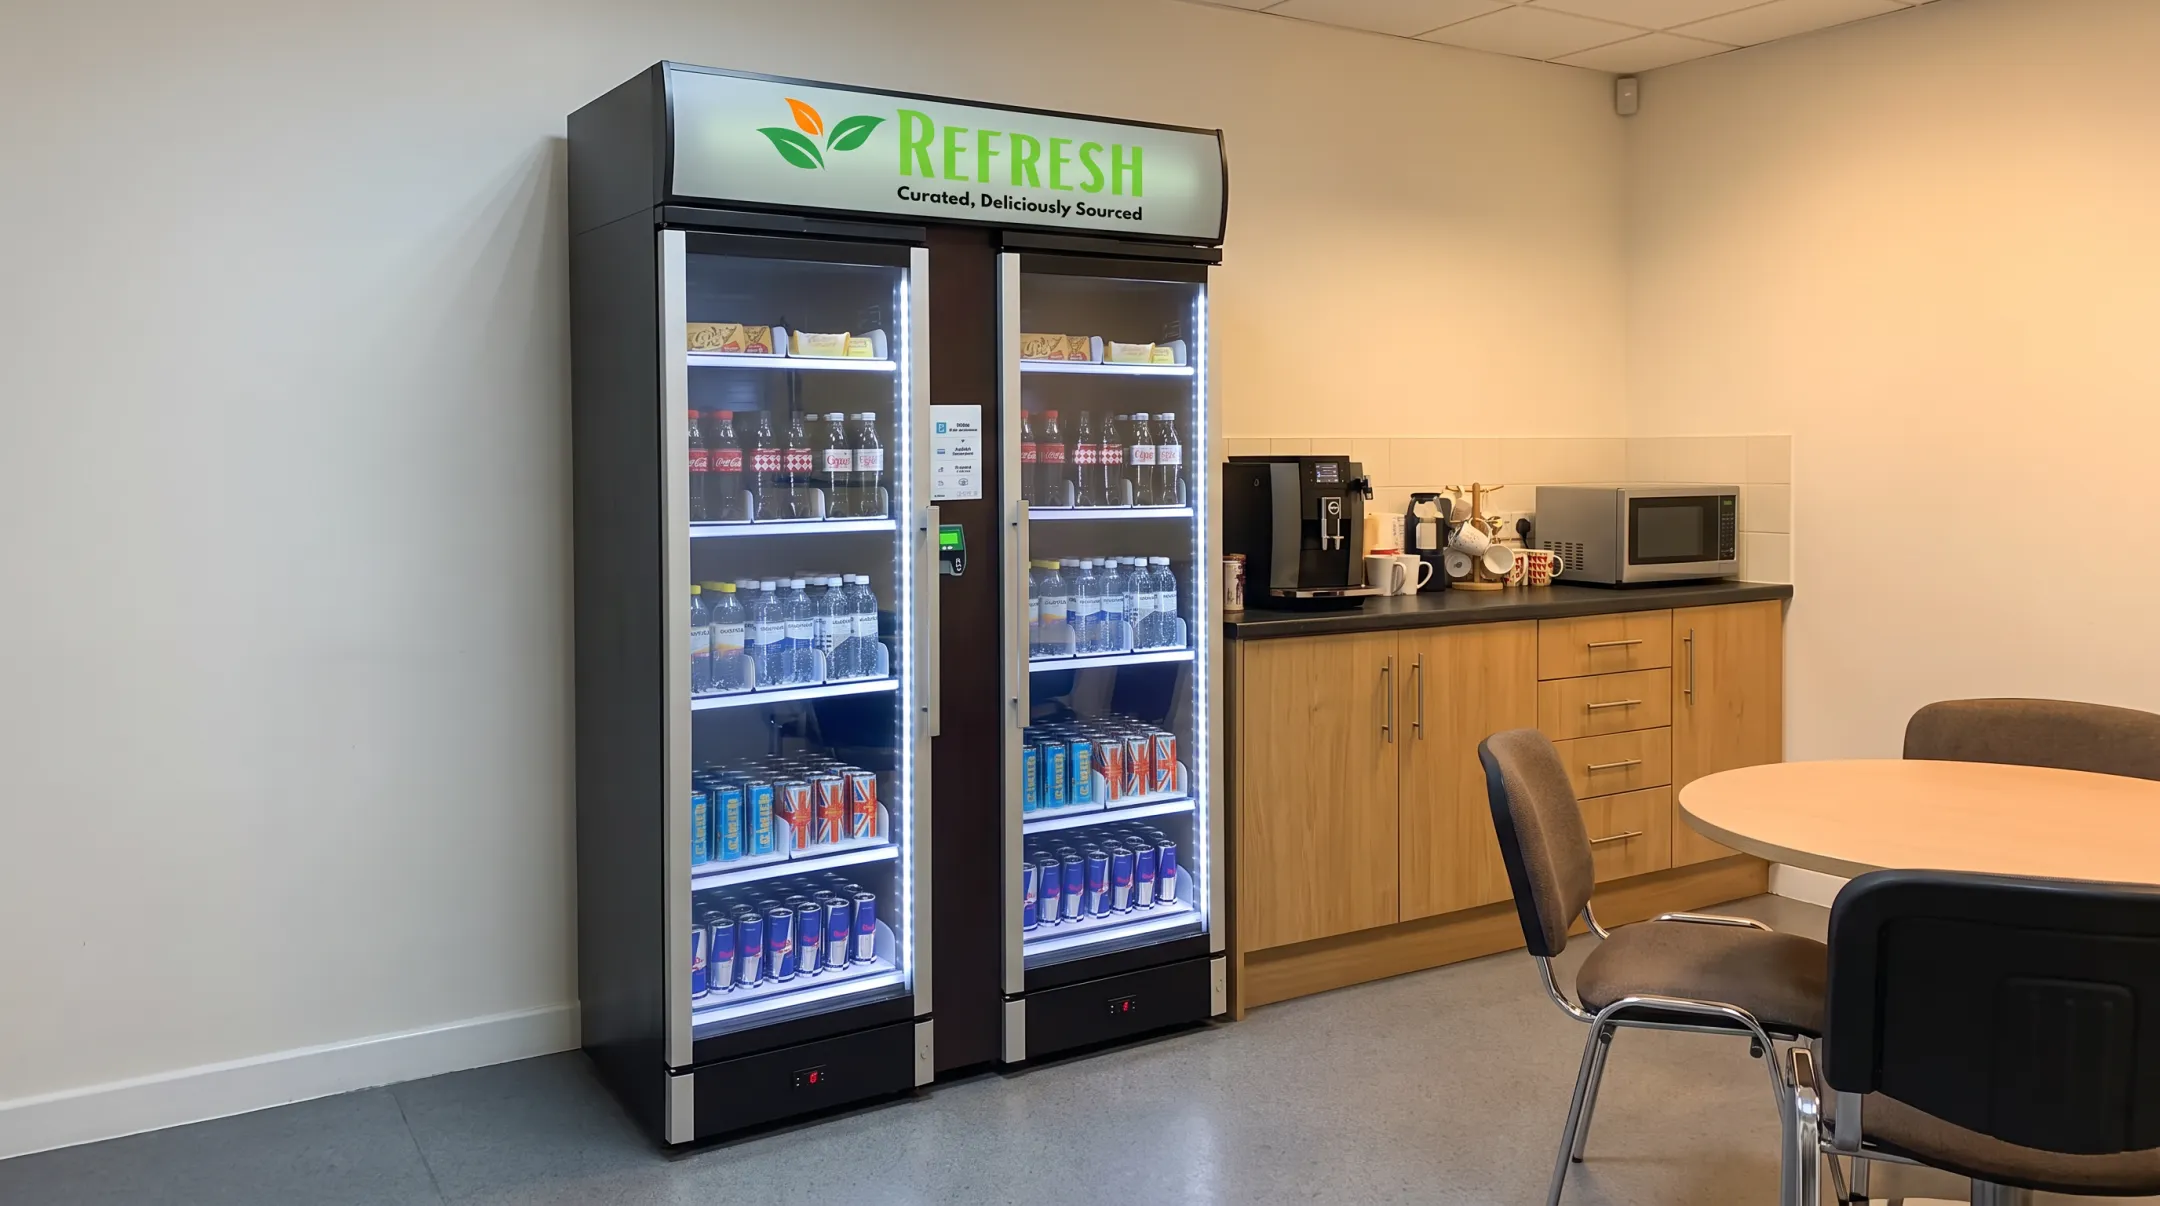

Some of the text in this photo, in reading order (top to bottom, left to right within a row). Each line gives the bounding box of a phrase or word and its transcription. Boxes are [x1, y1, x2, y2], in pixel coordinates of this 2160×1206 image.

[897, 108, 1144, 198] REFRESH
[897, 186, 1143, 221] Curated, Deliciously Sourced
